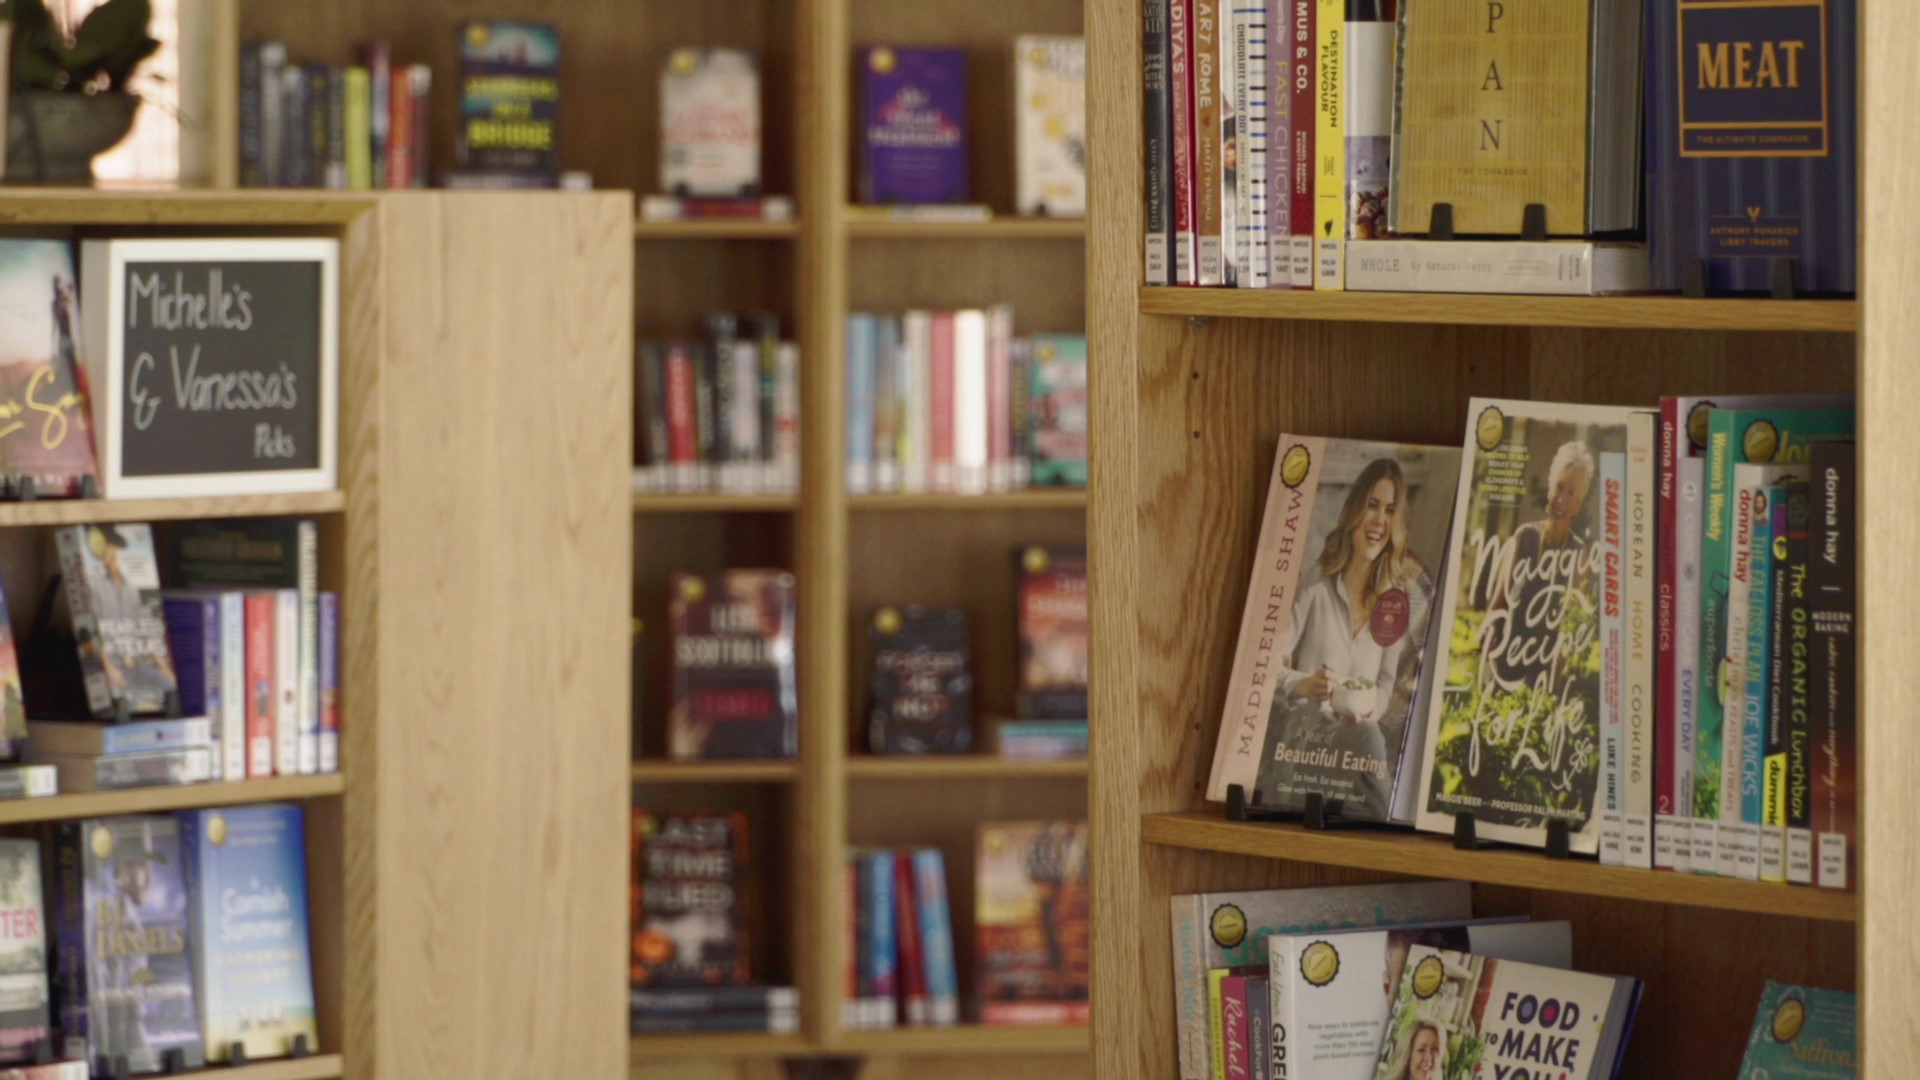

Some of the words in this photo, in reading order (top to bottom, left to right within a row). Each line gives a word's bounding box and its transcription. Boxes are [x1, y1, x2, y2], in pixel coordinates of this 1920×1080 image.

[1171, 0, 1185, 74] DIYA'S
[1198, 0, 1213, 45] ART
[1236, 24, 1246, 80] CHOCOLATE
[1296, 46, 1307, 59] &
[1696, 40, 1804, 89] MEAT
[1198, 52, 1212, 109] ROME
[1237, 82, 1247, 112] EVERY
[1274, 60, 1288, 118] FAST
[1296, 63, 1307, 94] CO.
[1320, 45, 1330, 113] FLAVOUR
[1329, 29, 1338, 128] DESTINATION
[1238, 114, 1247, 135] DAY
[1715, 135, 1757, 144] ULTIMATE
[1273, 125, 1290, 236] CHICKEN
[1360, 258, 1400, 273] WHOLE
[1411, 261, 1422, 272] by
[1425, 260, 1462, 272] Natural
[128, 267, 252, 331] Michelle's
[129, 352, 162, 430] &
[169, 343, 298, 411] Vanessa's
[1662, 421, 1674, 468] donna
[1709, 432, 1728, 491] Women's
[1661, 472, 1673, 499] hay
[1824, 467, 1839, 526] donna
[1604, 478, 1621, 548] SMART
[1632, 492, 1644, 578] KOREAN
[1706, 492, 1725, 541] Weekly
[1736, 489, 1752, 551] donna
[1734, 552, 1750, 584] hay
[1751, 535, 1767, 567] THE
[1823, 530, 1840, 564] hay
[1604, 551, 1621, 618] CARBS
[1791, 563, 1806, 598] The
[1237, 585, 1284, 757] MADELEINE
[1276, 487, 1303, 572] SHAW
[1632, 600, 1644, 661] HOME
[1659, 584, 1673, 652] classics
[1773, 569, 1785, 658] Mediterranean
[1812, 611, 1852, 622] MODERN
[1814, 622, 1849, 633] BAKING
[1477, 608, 1595, 692] Recipe
[1704, 598, 1717, 689] superfoods
[1746, 640, 1762, 683] PLAN
[1791, 607, 1808, 725] ORGANIC
[1681, 669, 1693, 720] EVERY
[1772, 660, 1782, 684] Diet
[1511, 670, 1588, 773] Life
[1631, 684, 1643, 784] COOKING
[1729, 705, 1738, 745] FEASTS
[1744, 693, 1761, 727] JOE
[1769, 686, 1780, 746] Cookbook
[1274, 743, 1339, 769] Beautiful
[1341, 750, 1388, 779] Eating
[1606, 737, 1616, 769] LUKE
[1680, 721, 1692, 753] DAY
[1727, 747, 1736, 769] and
[1742, 731, 1759, 795] WICKS
[1791, 730, 1808, 819] Lunchbox
[1436, 792, 1462, 804] MAGGIE
[1462, 795, 1483, 807] BEER
[1490, 799, 1533, 813] PROFESSOR
[1606, 777, 1616, 810] HINES
[1658, 796, 1668, 814] 2
[1725, 769, 1736, 812] TREATS
[1180, 917, 1195, 980] donna
[1183, 985, 1197, 1023] hay
[1324, 1022, 1341, 1031] ways
[1349, 1019, 1380, 1028] celebrate
[1500, 991, 1581, 1032] FOOD
[1223, 995, 1246, 1076] Rachel
[1272, 1022, 1287, 1080] GRE
[1331, 1041, 1346, 1049] than
[1359, 1041, 1375, 1050] easy
[1351, 1050, 1376, 1060] recipes
[1484, 1031, 1499, 1046] TO
[1497, 1028, 1580, 1068] MAKE
